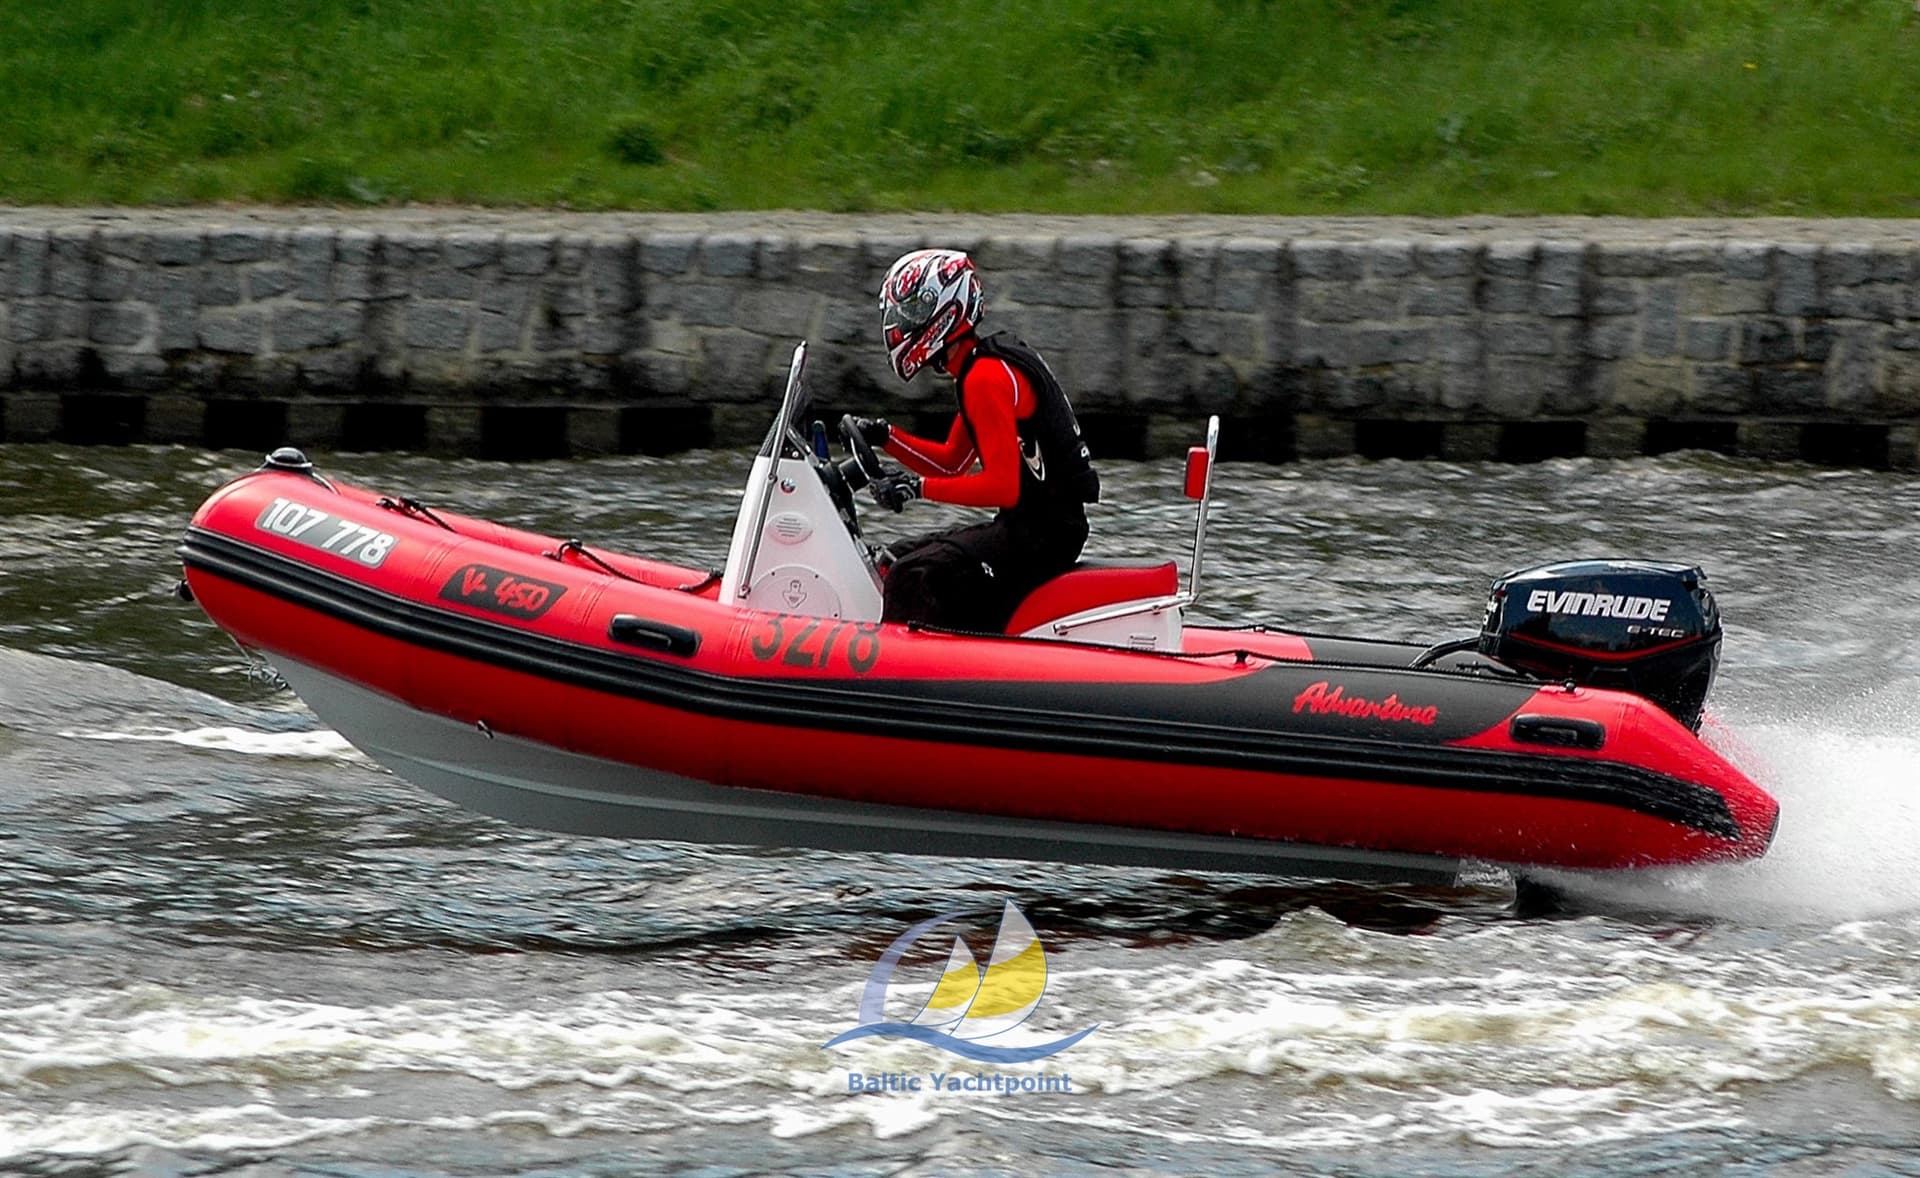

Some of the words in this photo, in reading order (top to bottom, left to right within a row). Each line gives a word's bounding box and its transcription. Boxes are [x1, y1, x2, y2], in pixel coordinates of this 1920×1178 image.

[262, 497, 328, 537] 107
[321, 519, 394, 564] 778
[494, 576, 550, 612] 450
[1528, 589, 1671, 622] EVINRUDE
[752, 614, 881, 673] 3278
[1626, 625, 1685, 638] E-TEC
